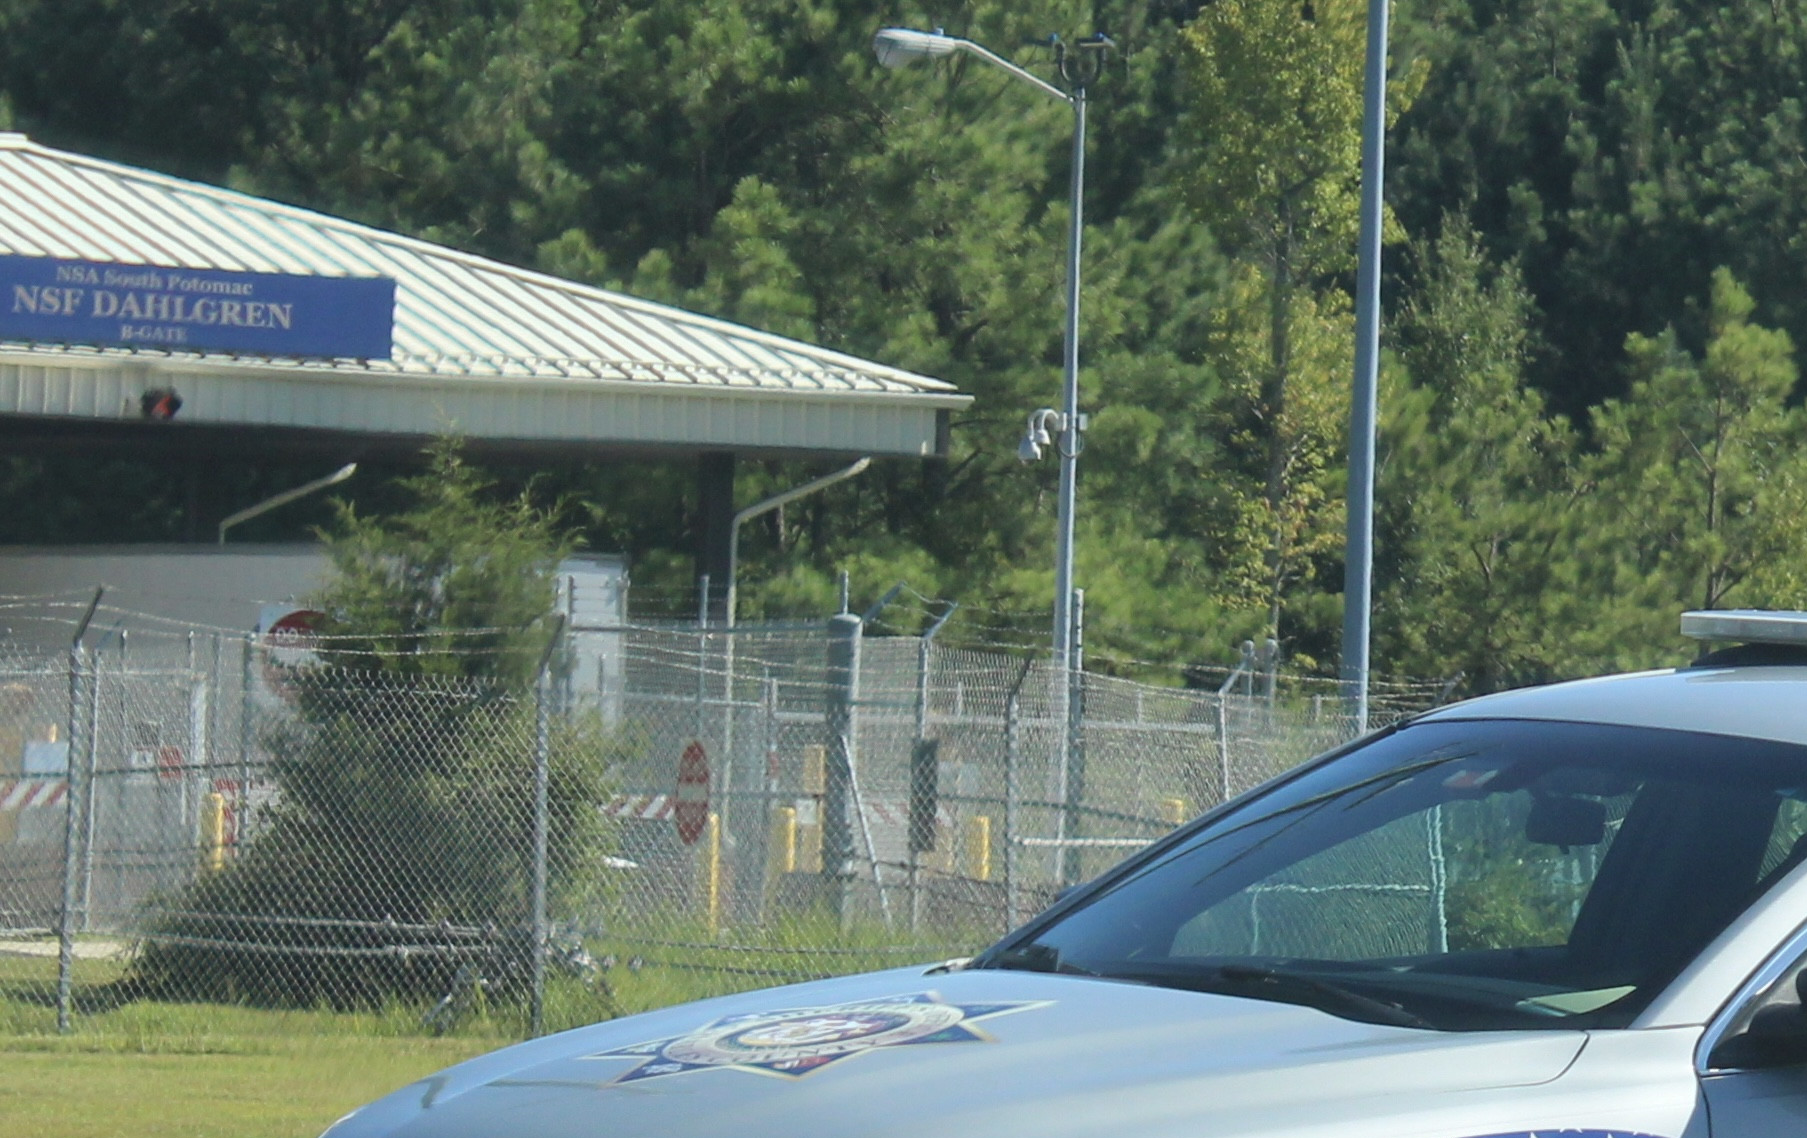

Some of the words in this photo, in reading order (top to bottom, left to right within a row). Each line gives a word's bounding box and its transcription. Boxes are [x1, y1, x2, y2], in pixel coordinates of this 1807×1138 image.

[56, 265, 99, 285] NSA
[103, 268, 163, 289] South
[167, 274, 253, 295] Potomac
[11, 285, 84, 315] NSF
[92, 290, 293, 330] DAHLGREN
[120, 325, 188, 342] B-GATE
